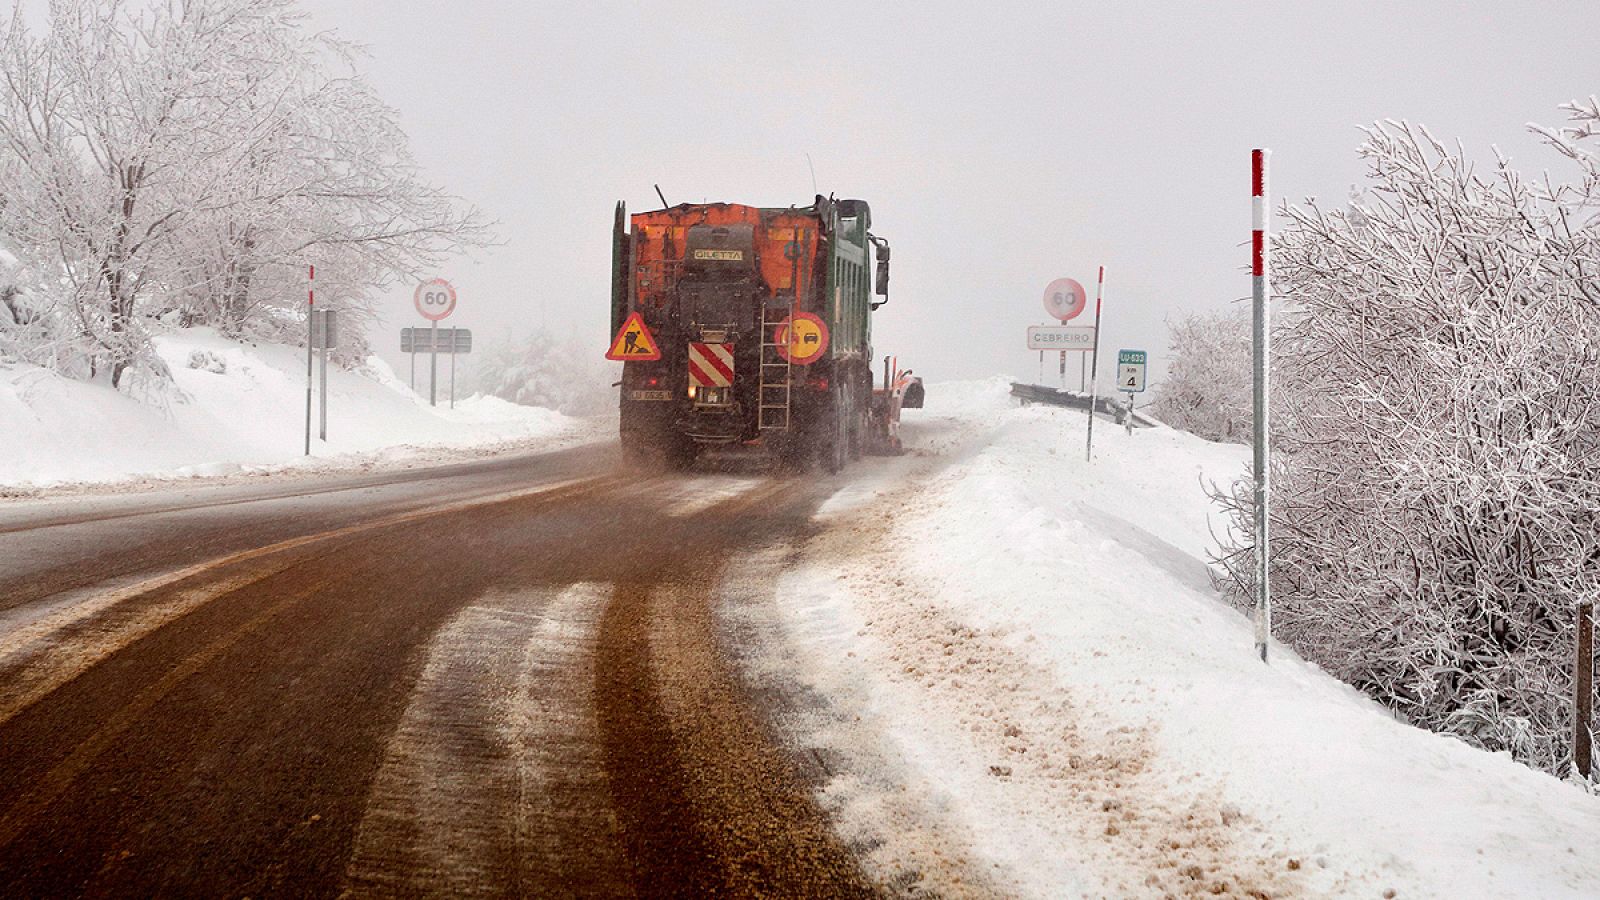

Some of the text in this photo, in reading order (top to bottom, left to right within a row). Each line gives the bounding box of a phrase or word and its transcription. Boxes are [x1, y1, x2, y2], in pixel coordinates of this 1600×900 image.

[695, 250, 741, 259] GILETTA
[425, 292, 447, 305] 60
[1053, 292, 1076, 305] 60
[1034, 333, 1089, 342] CEBREIRO
[1127, 376, 1137, 386] 4
